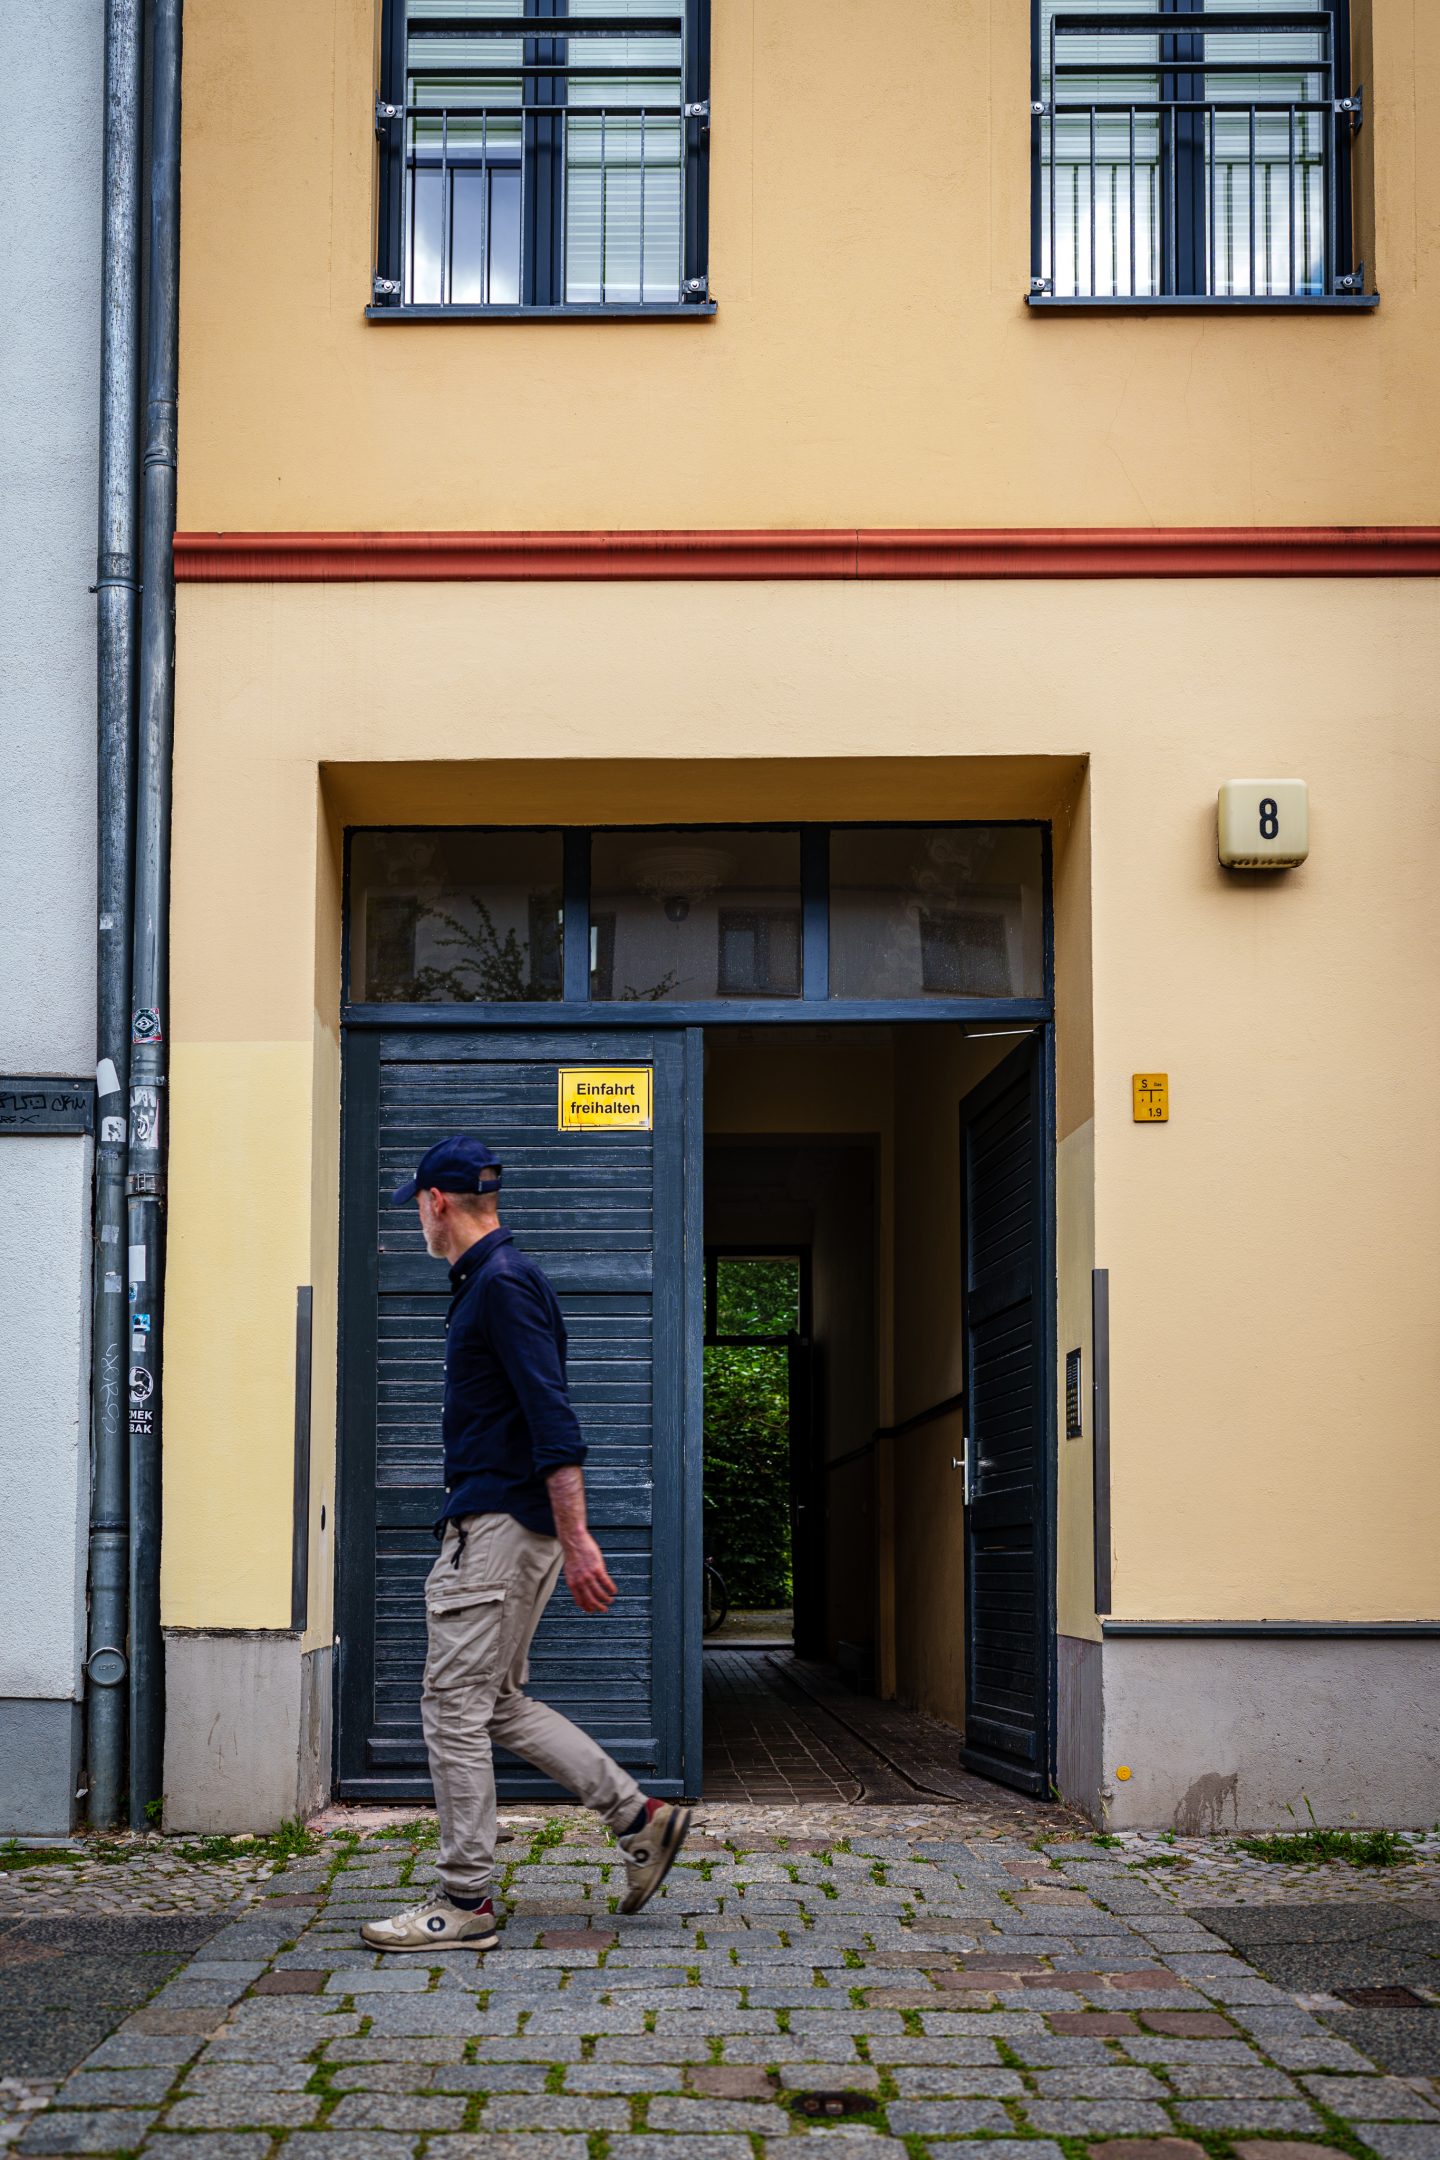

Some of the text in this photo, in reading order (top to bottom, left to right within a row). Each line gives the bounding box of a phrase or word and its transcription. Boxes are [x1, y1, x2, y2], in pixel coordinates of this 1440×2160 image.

[1259, 798, 1279, 840] 8
[577, 1083, 635, 1095] Einfahrt
[1141, 1079, 1148, 1089] S
[571, 1102, 640, 1114] freihalten
